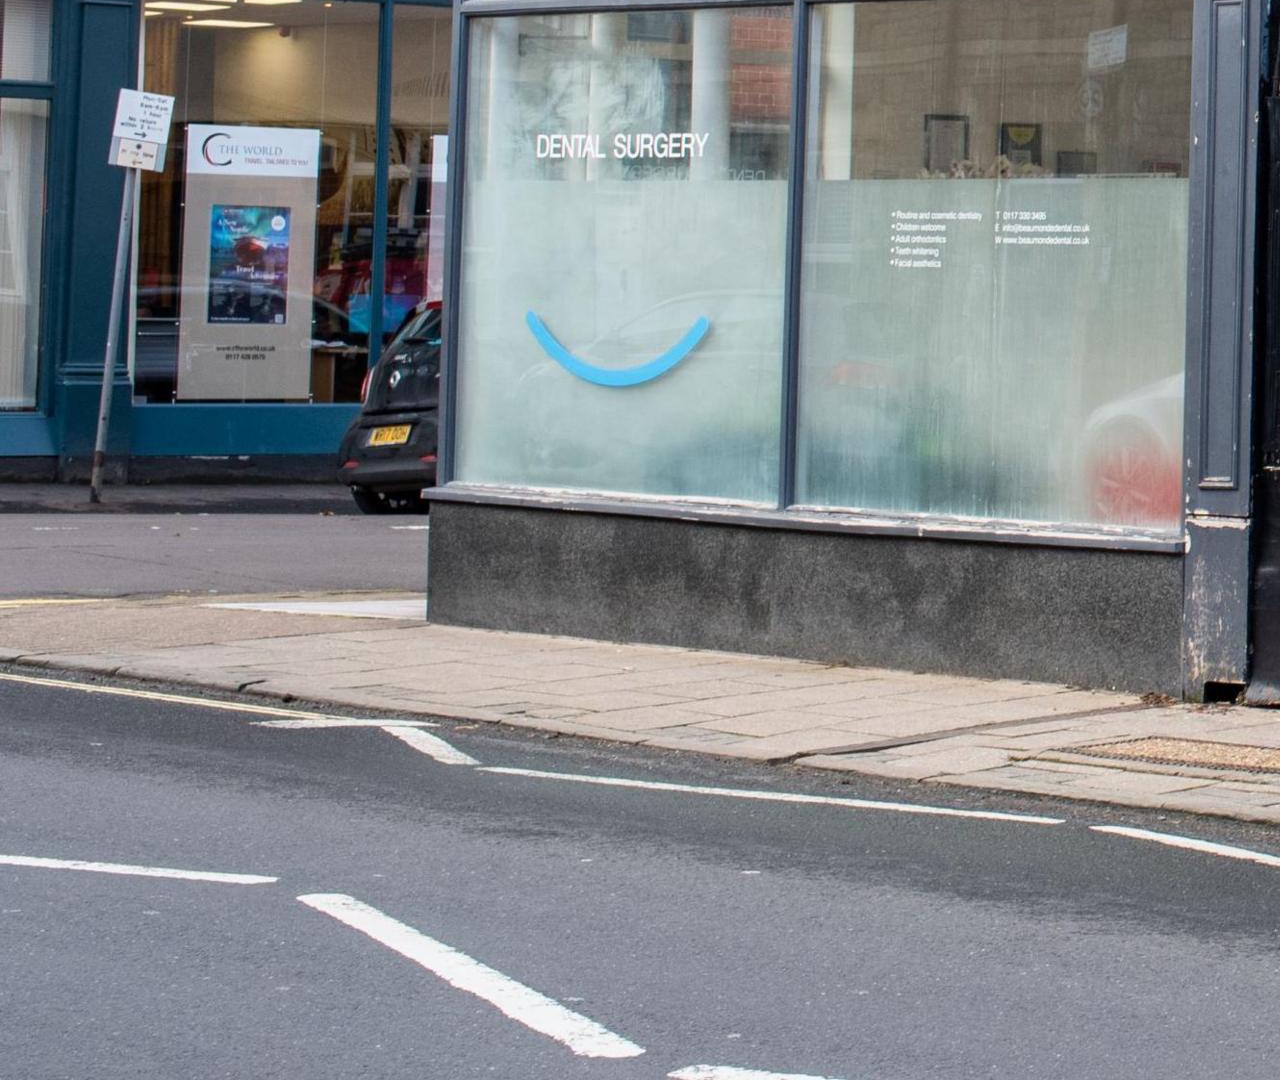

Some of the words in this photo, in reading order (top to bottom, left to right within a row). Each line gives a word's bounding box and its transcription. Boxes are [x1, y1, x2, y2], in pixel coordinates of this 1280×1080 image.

[219, 144, 239, 155] THE
[243, 144, 285, 156] WORLD
[537, 134, 606, 158] DENTAL
[613, 133, 709, 159] SURGERY
